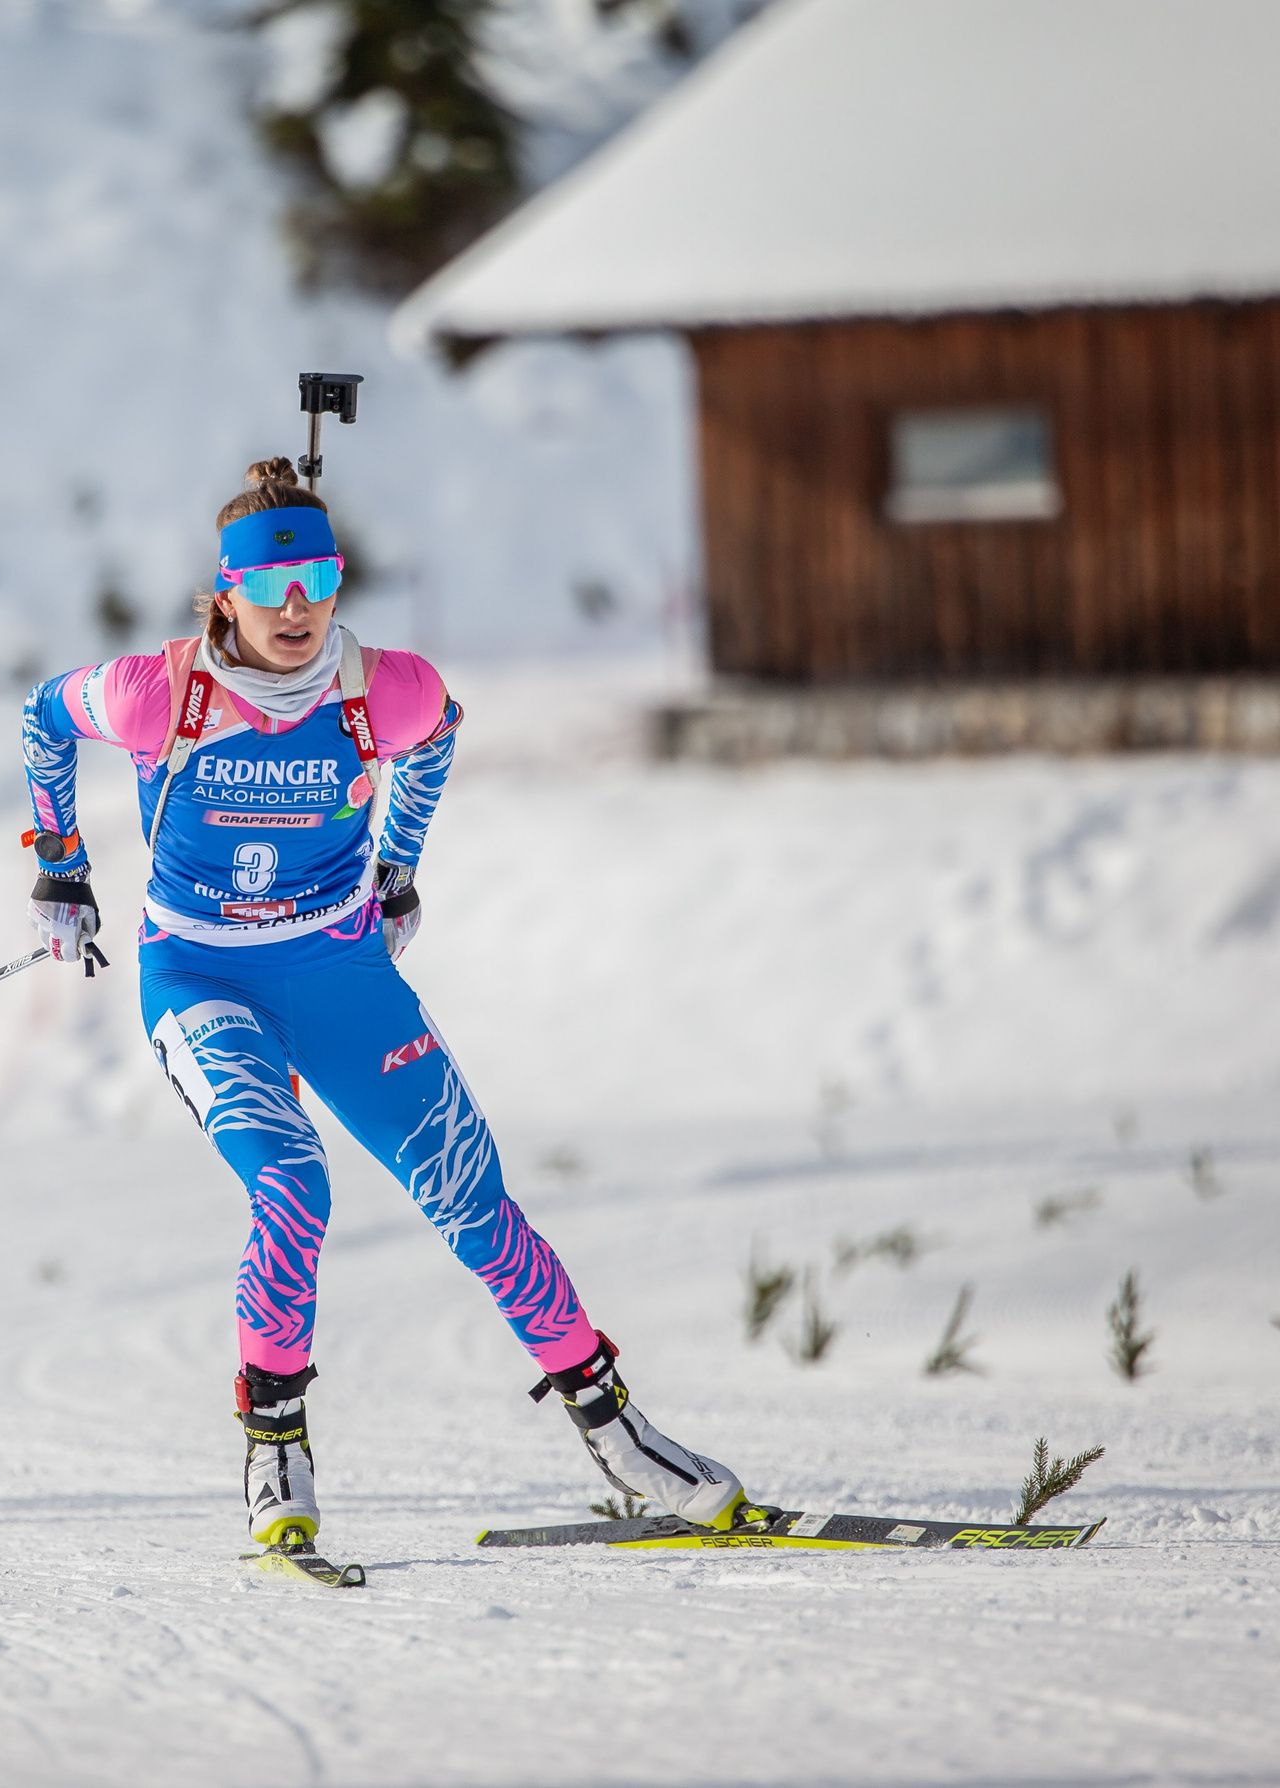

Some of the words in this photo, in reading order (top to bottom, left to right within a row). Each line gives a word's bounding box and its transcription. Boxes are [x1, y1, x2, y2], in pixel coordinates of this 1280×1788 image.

[195, 755, 341, 785] ERDINGER
[191, 785, 337, 804] ALKOHOLFREI
[218, 815, 311, 825] GRAPEFRUIT
[231, 842, 278, 895] 3
[231, 905, 286, 920] Tirol
[194, 1014, 258, 1042] GAZPROM
[245, 1427, 303, 1441] FISCHER
[700, 1537, 775, 1548] FISCHER
[948, 1529, 1081, 1548] FISCHER
